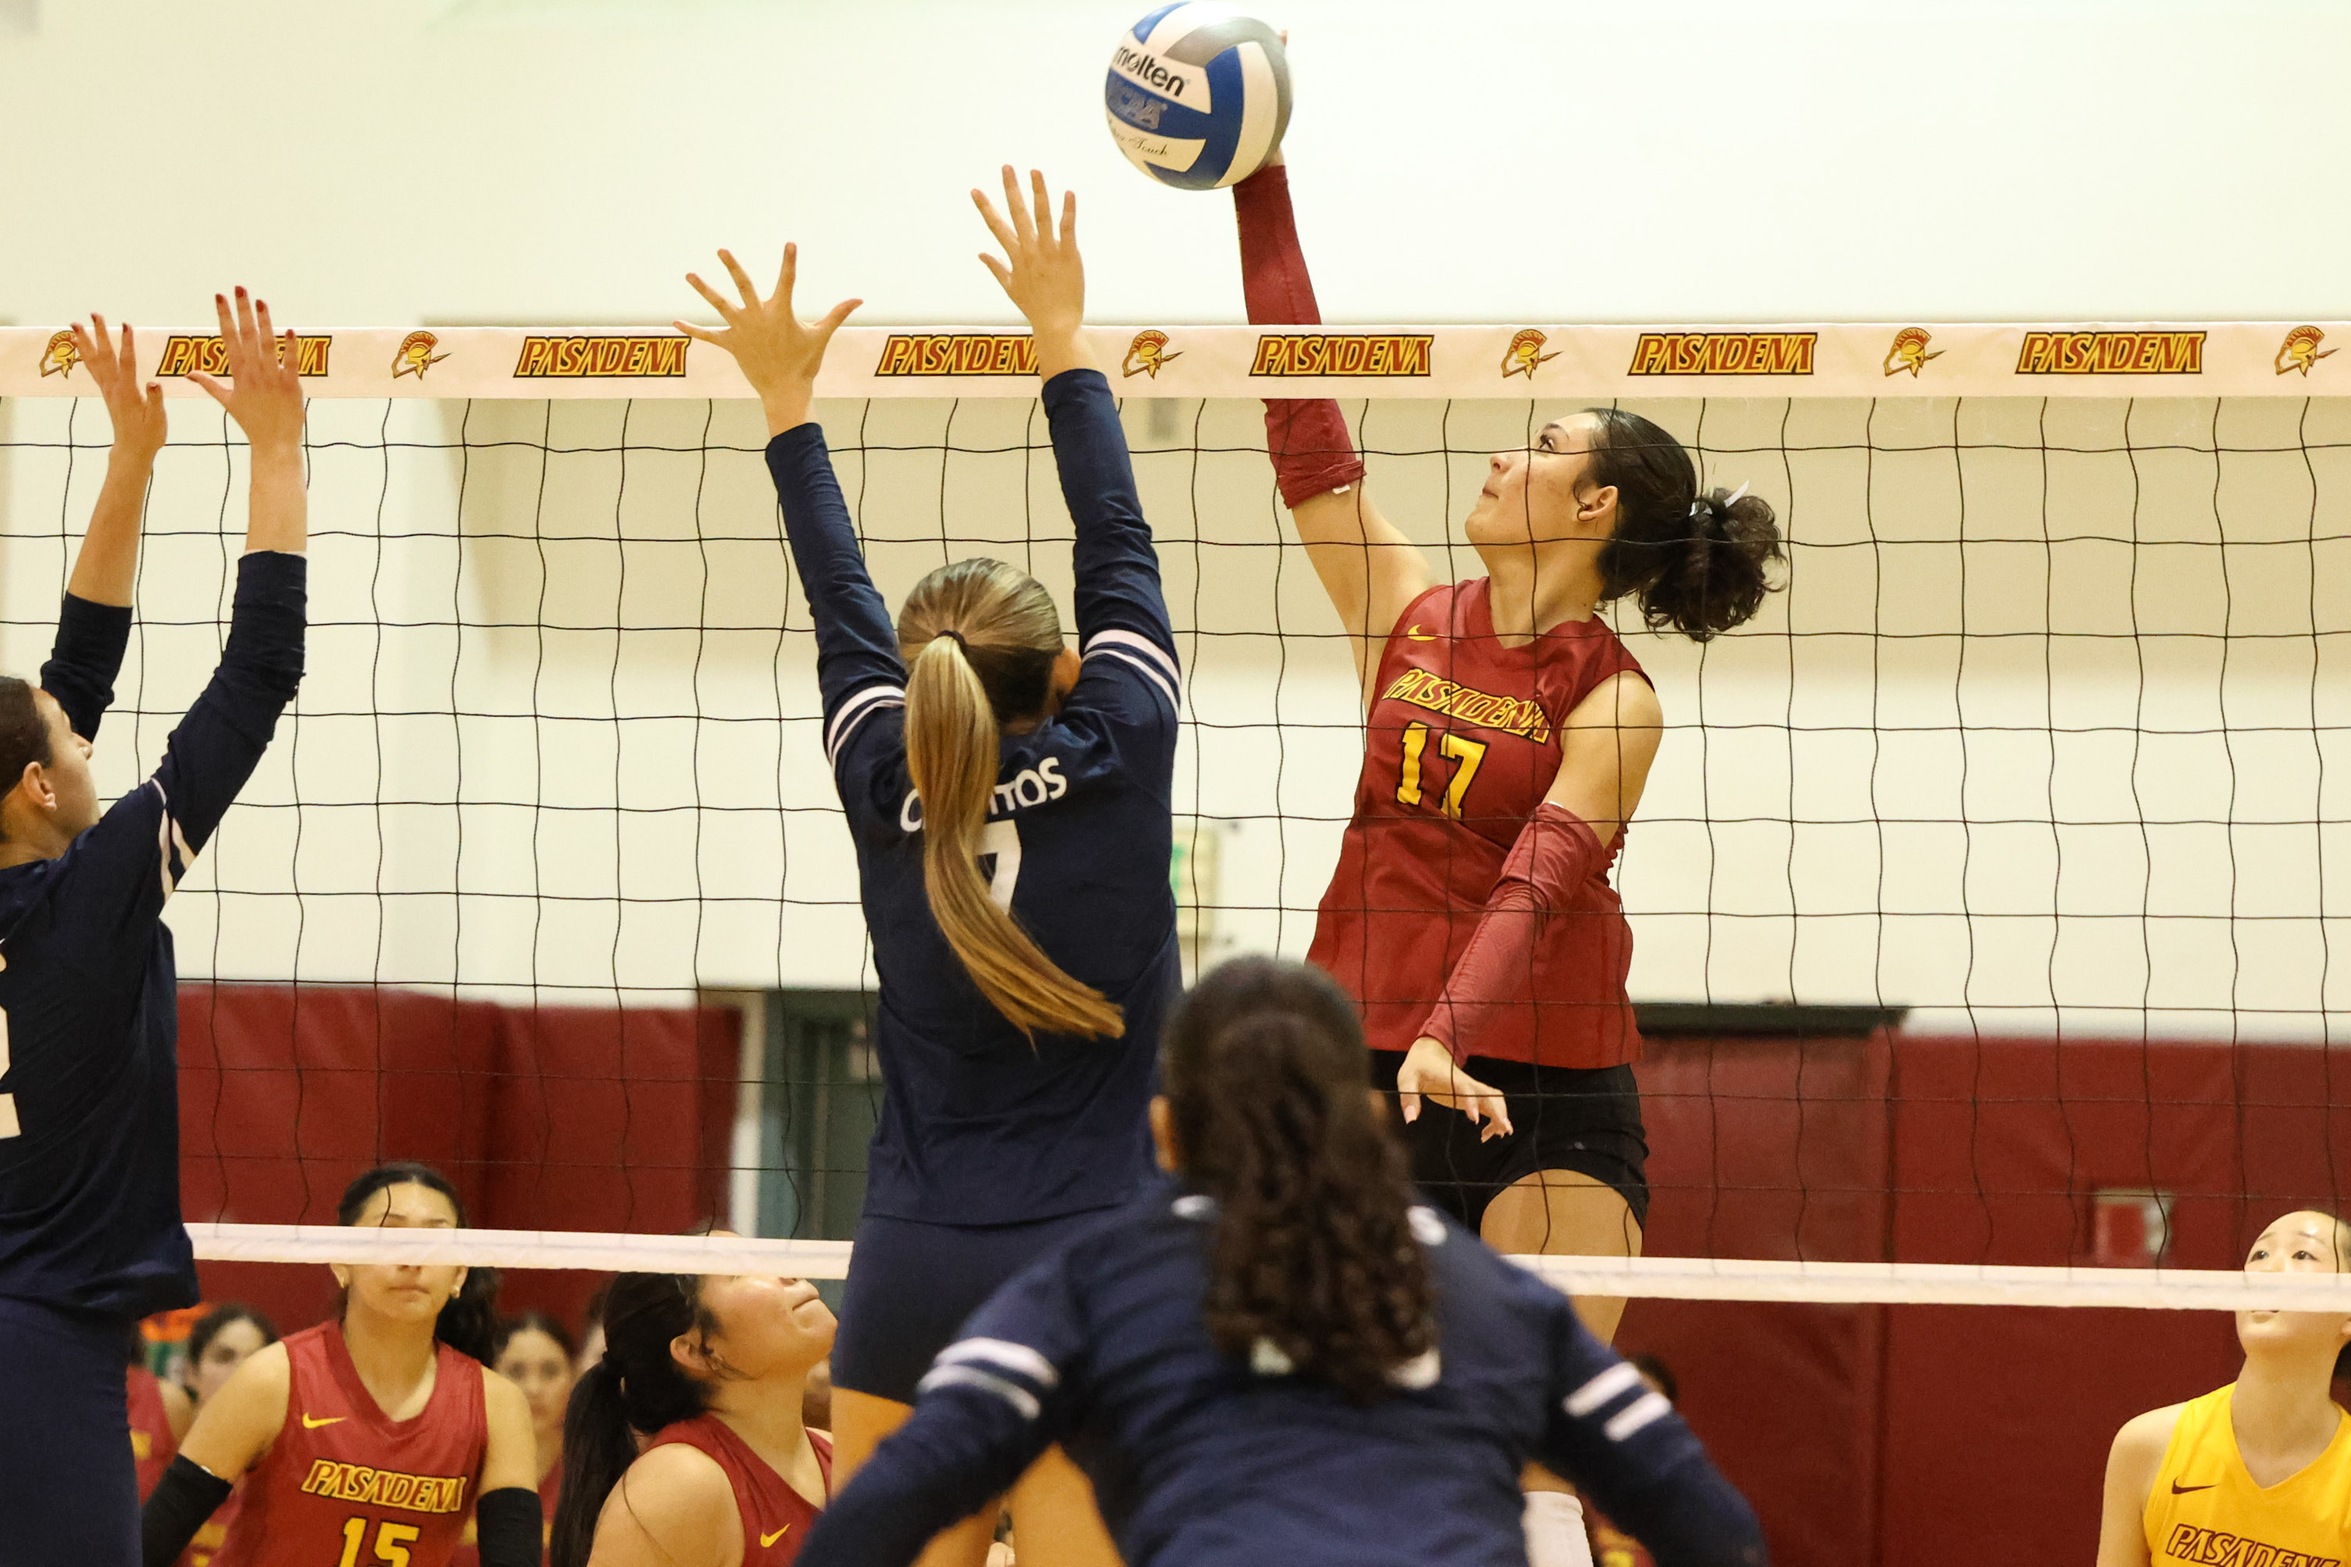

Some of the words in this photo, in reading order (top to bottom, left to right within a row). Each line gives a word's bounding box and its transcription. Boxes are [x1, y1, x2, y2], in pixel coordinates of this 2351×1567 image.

[513, 336, 692, 378] PASADENA
[874, 334, 1041, 376] PASADEN
[1248, 334, 1434, 377] PASADENA
[1627, 332, 1817, 376] PASADENA
[2015, 331, 2207, 374] PASADENA
[1382, 667, 1551, 745] PASADENA
[1396, 720, 1489, 820] 17
[973, 819, 1022, 916] 7
[339, 1516, 420, 1567] 15
